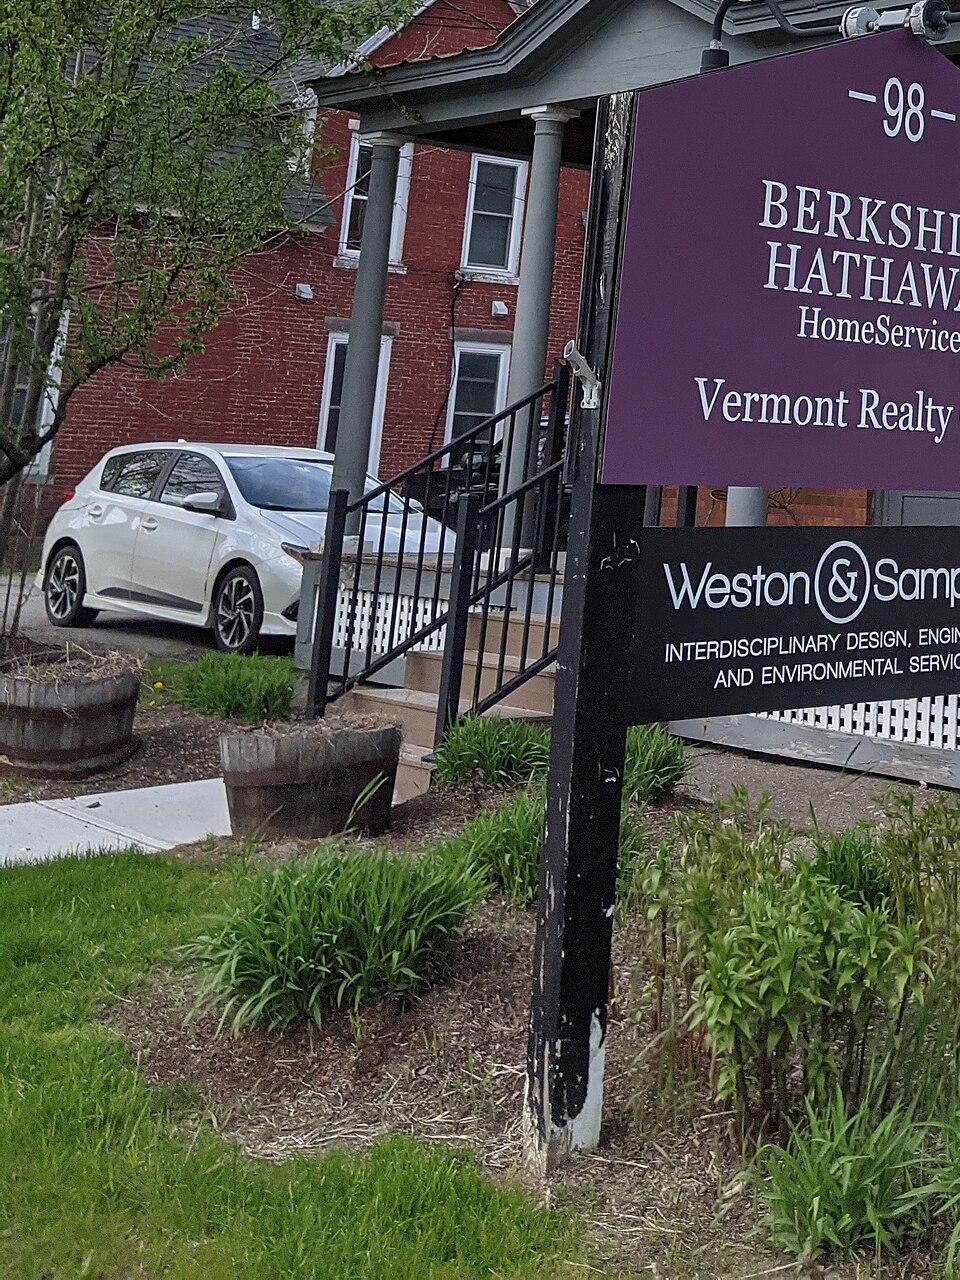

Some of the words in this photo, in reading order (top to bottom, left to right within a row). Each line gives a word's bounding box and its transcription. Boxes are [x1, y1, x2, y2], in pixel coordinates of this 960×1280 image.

[694, 377, 849, 428] Vermont
[856, 388, 954, 444] Realty
[663, 562, 811, 610] Weston
[664, 633, 841, 663] INTERDISCIPLINARY
[846, 628, 913, 651] DESIGN,
[713, 669, 754, 689] AND
[761, 657, 904, 685] ENVIRONMENTAL
